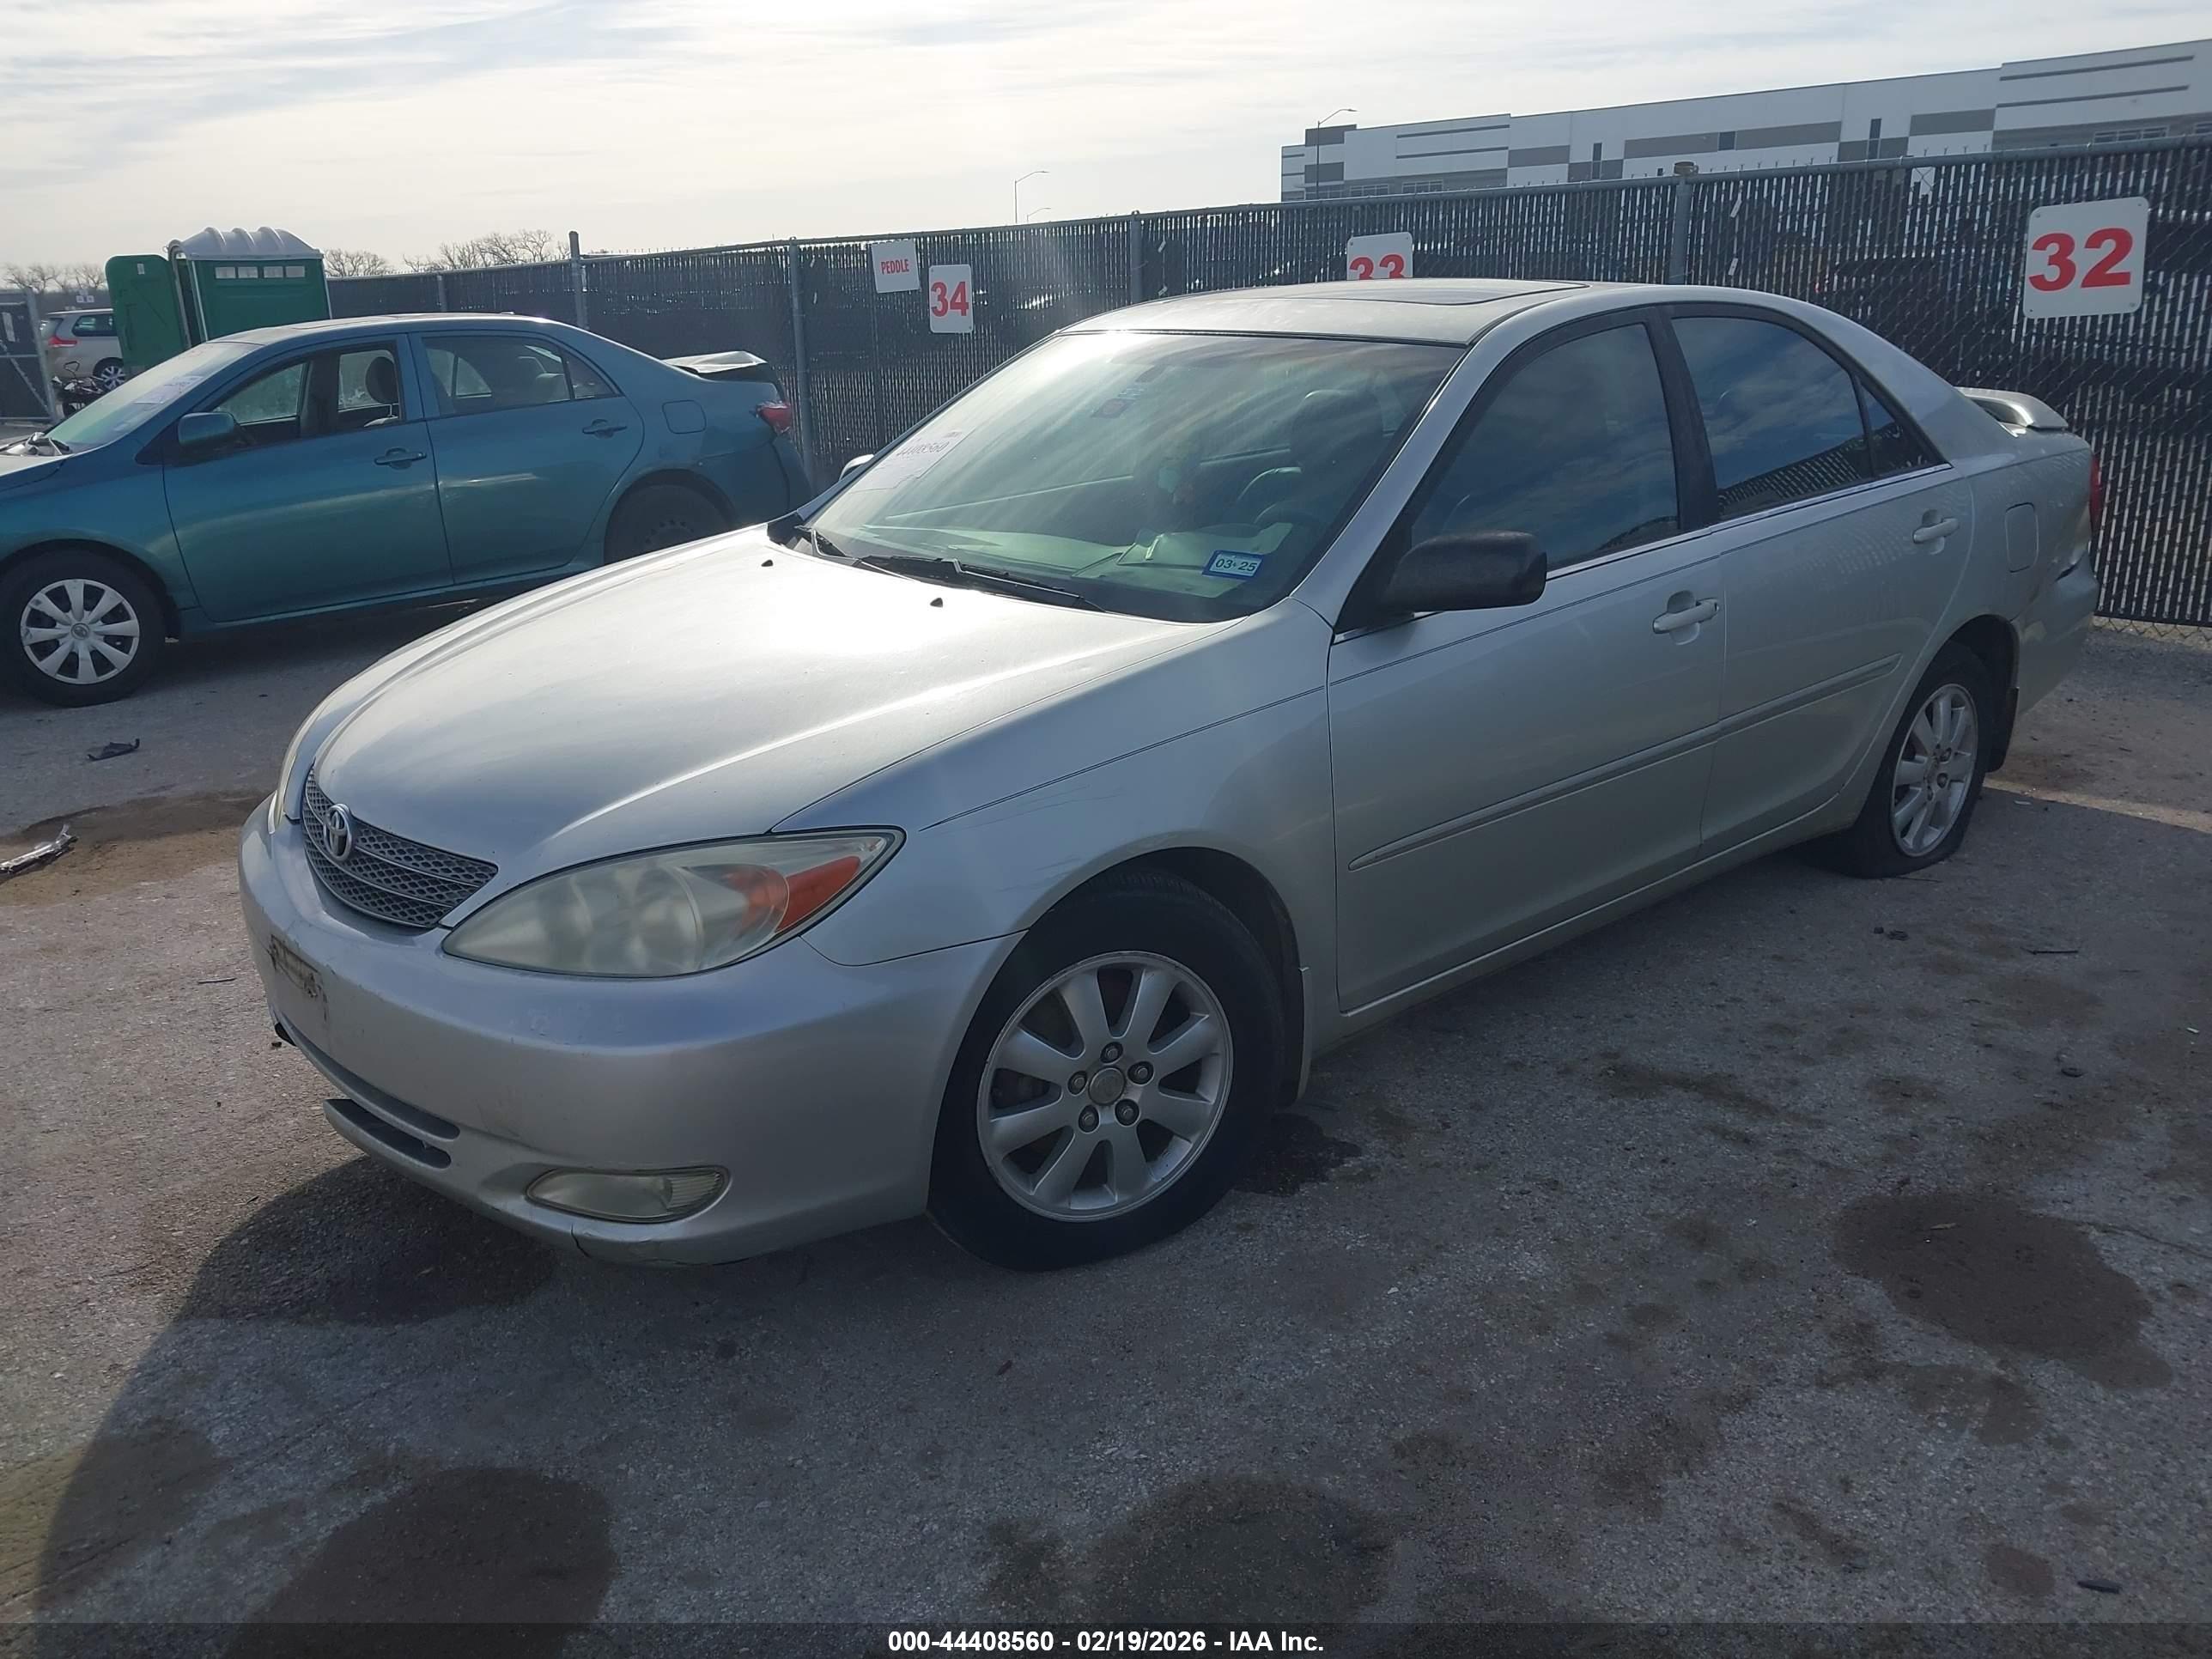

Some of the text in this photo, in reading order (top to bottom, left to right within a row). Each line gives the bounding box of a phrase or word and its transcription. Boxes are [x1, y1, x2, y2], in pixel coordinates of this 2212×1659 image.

[880, 258, 910, 274] PEDDLE
[2028, 228, 2133, 291] 32
[931, 281, 969, 317] 34
